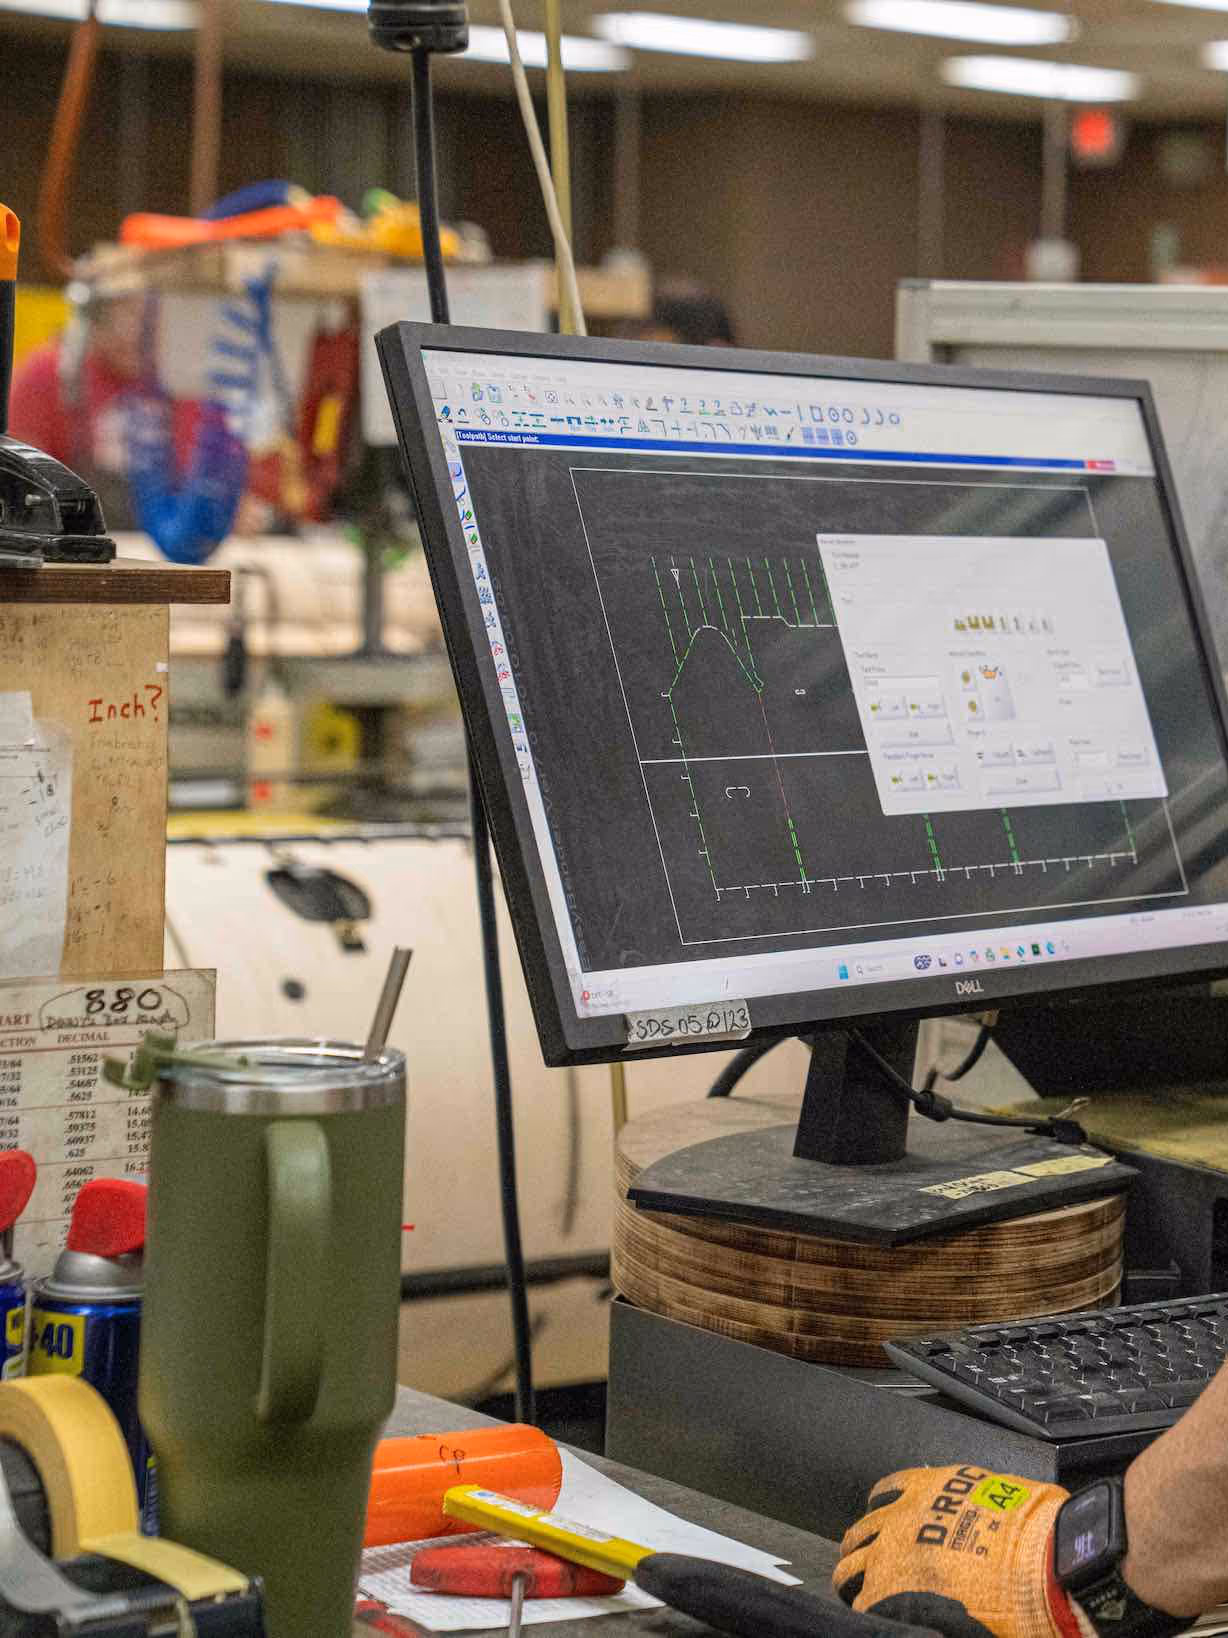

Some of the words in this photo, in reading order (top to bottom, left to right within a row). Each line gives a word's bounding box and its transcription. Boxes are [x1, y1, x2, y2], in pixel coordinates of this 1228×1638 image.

[487, 432, 507, 441] Select
[508, 434, 521, 442] start
[88, 684, 162, 723] Inch?
[955, 979, 984, 994] DELL
[85, 987, 163, 1014] 880
[57, 1031, 110, 1043] DECIMAL
[68, 1054, 98, 1064] .51562
[65, 1148, 86, 1158] .625
[987, 1481, 1021, 1510] A4
